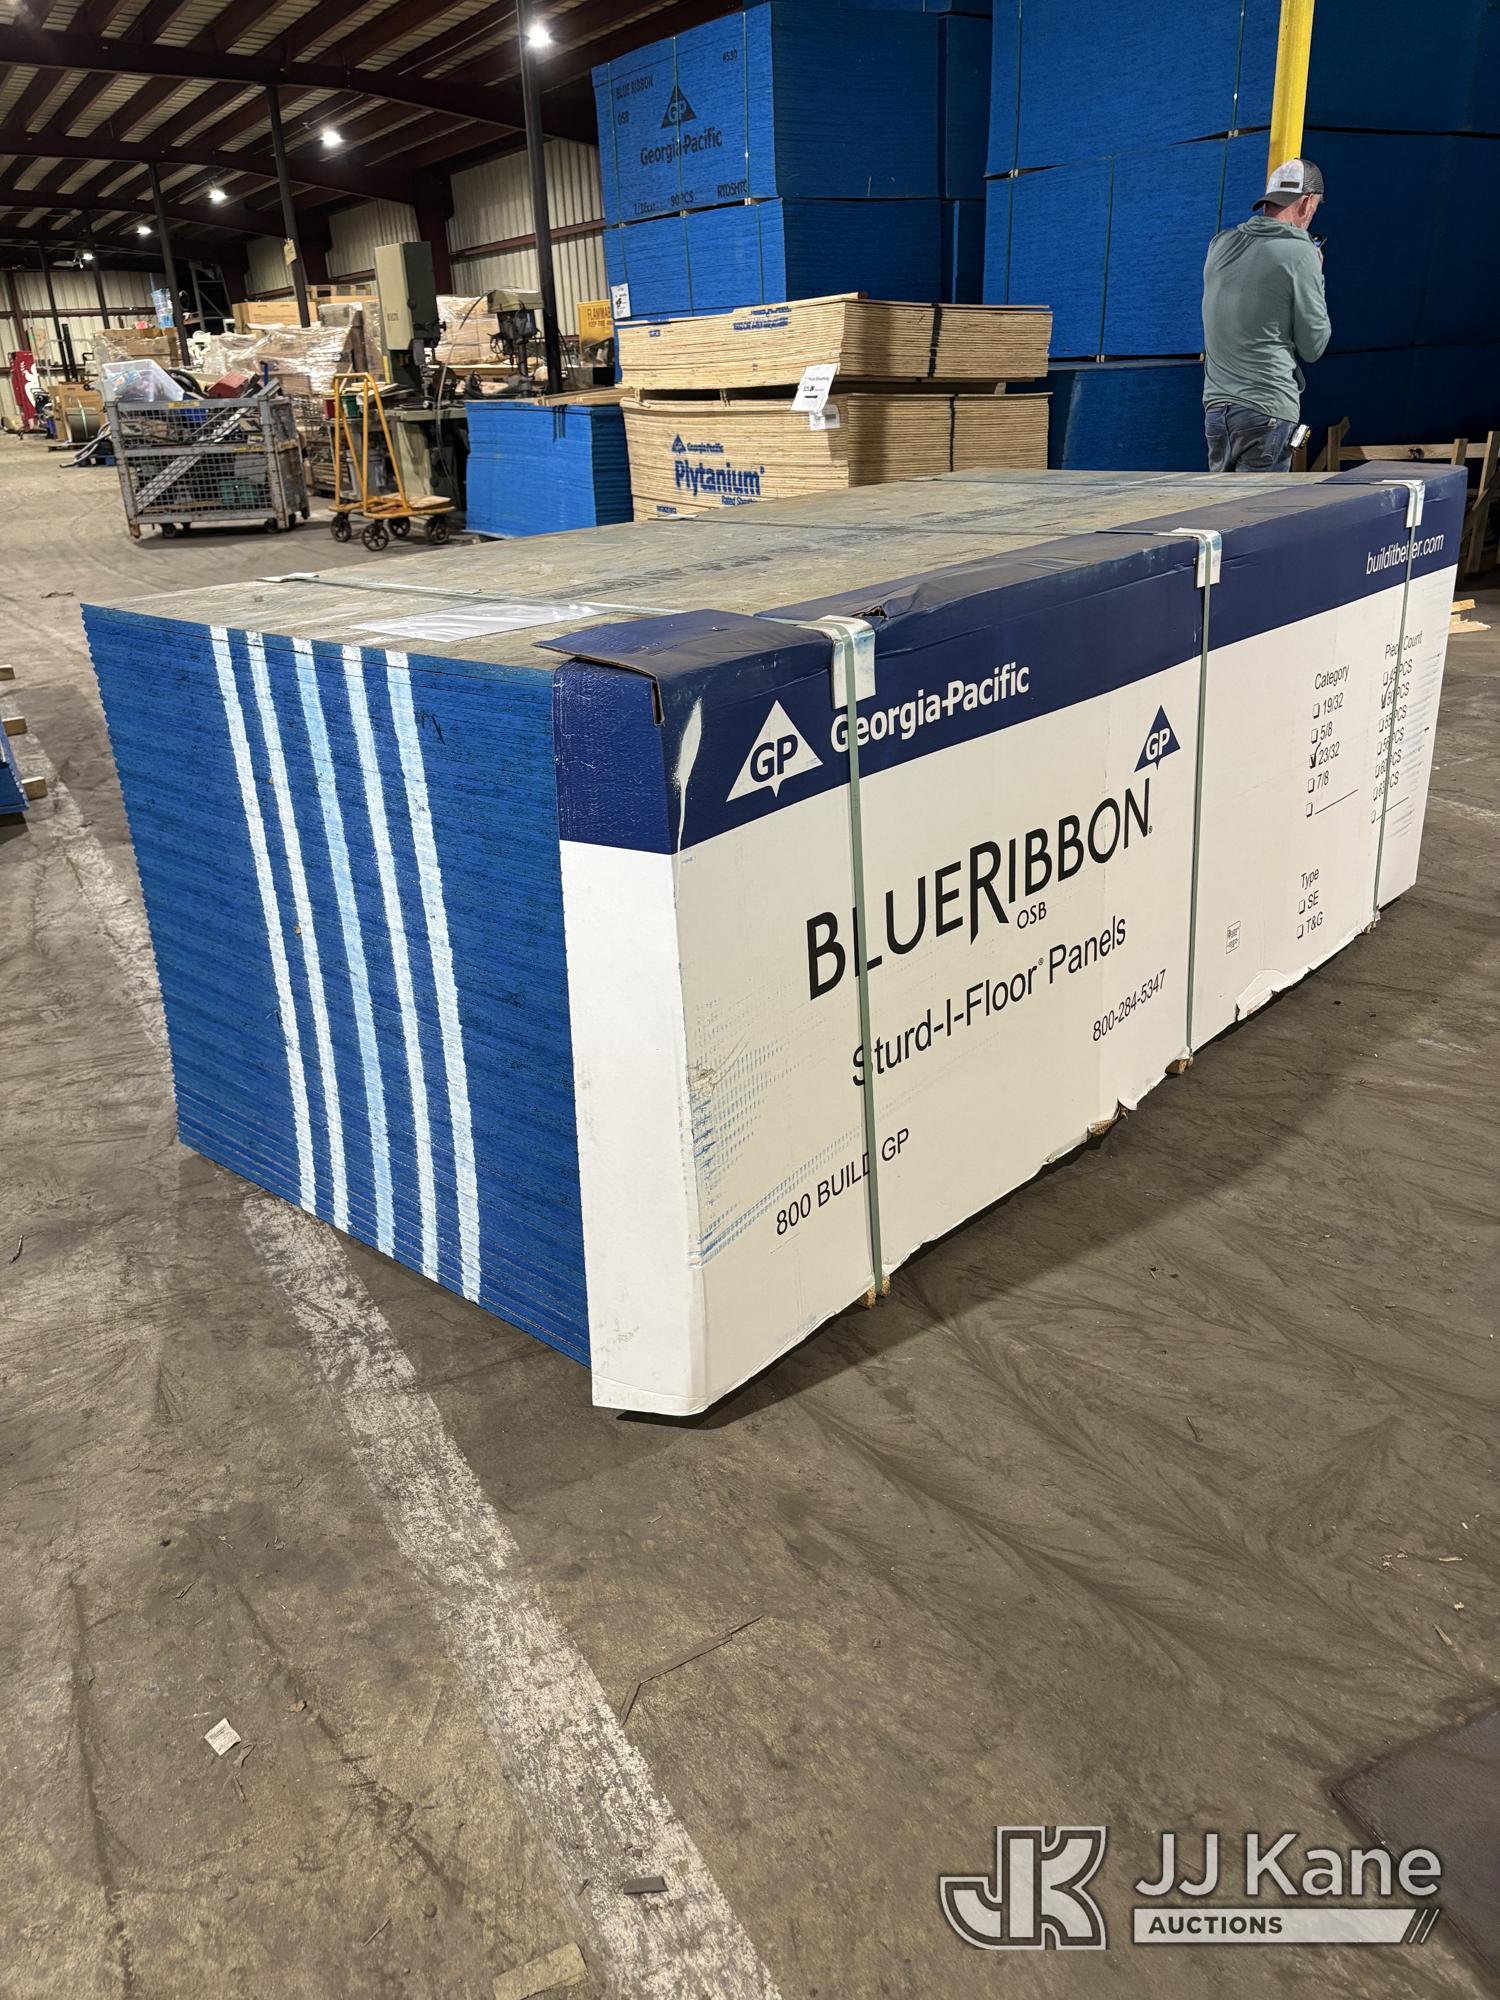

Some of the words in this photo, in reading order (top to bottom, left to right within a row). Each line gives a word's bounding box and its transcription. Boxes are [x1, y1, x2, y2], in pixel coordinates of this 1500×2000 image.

[667, 100, 688, 122] GP
[675, 459, 761, 496] Plytanium
[1366, 534, 1445, 575] builditbeter.com
[1384, 643, 1401, 660] Piec
[1403, 629, 1422, 650] Count
[1313, 665, 1350, 690] Category
[1322, 692, 1344, 716] 19/32
[1320, 721, 1333, 741] 5/8
[1145, 727, 1171, 761] GP
[1318, 741, 1341, 766] 23/32
[750, 733, 798, 783] GP
[1390, 749, 1402, 765] CS
[1317, 770, 1330, 790] 7/8
[1389, 771, 1400, 788] CS
[1301, 868, 1320, 890] Type
[1307, 890, 1320, 909] SE
[1016, 901, 1047, 930] OSB
[1306, 912, 1323, 934] T&G
[1049, 915, 1126, 984] Panels
[1093, 968, 1166, 1041] 800-284-5347
[776, 1193, 811, 1235] 800
[881, 1128, 909, 1161] GP
